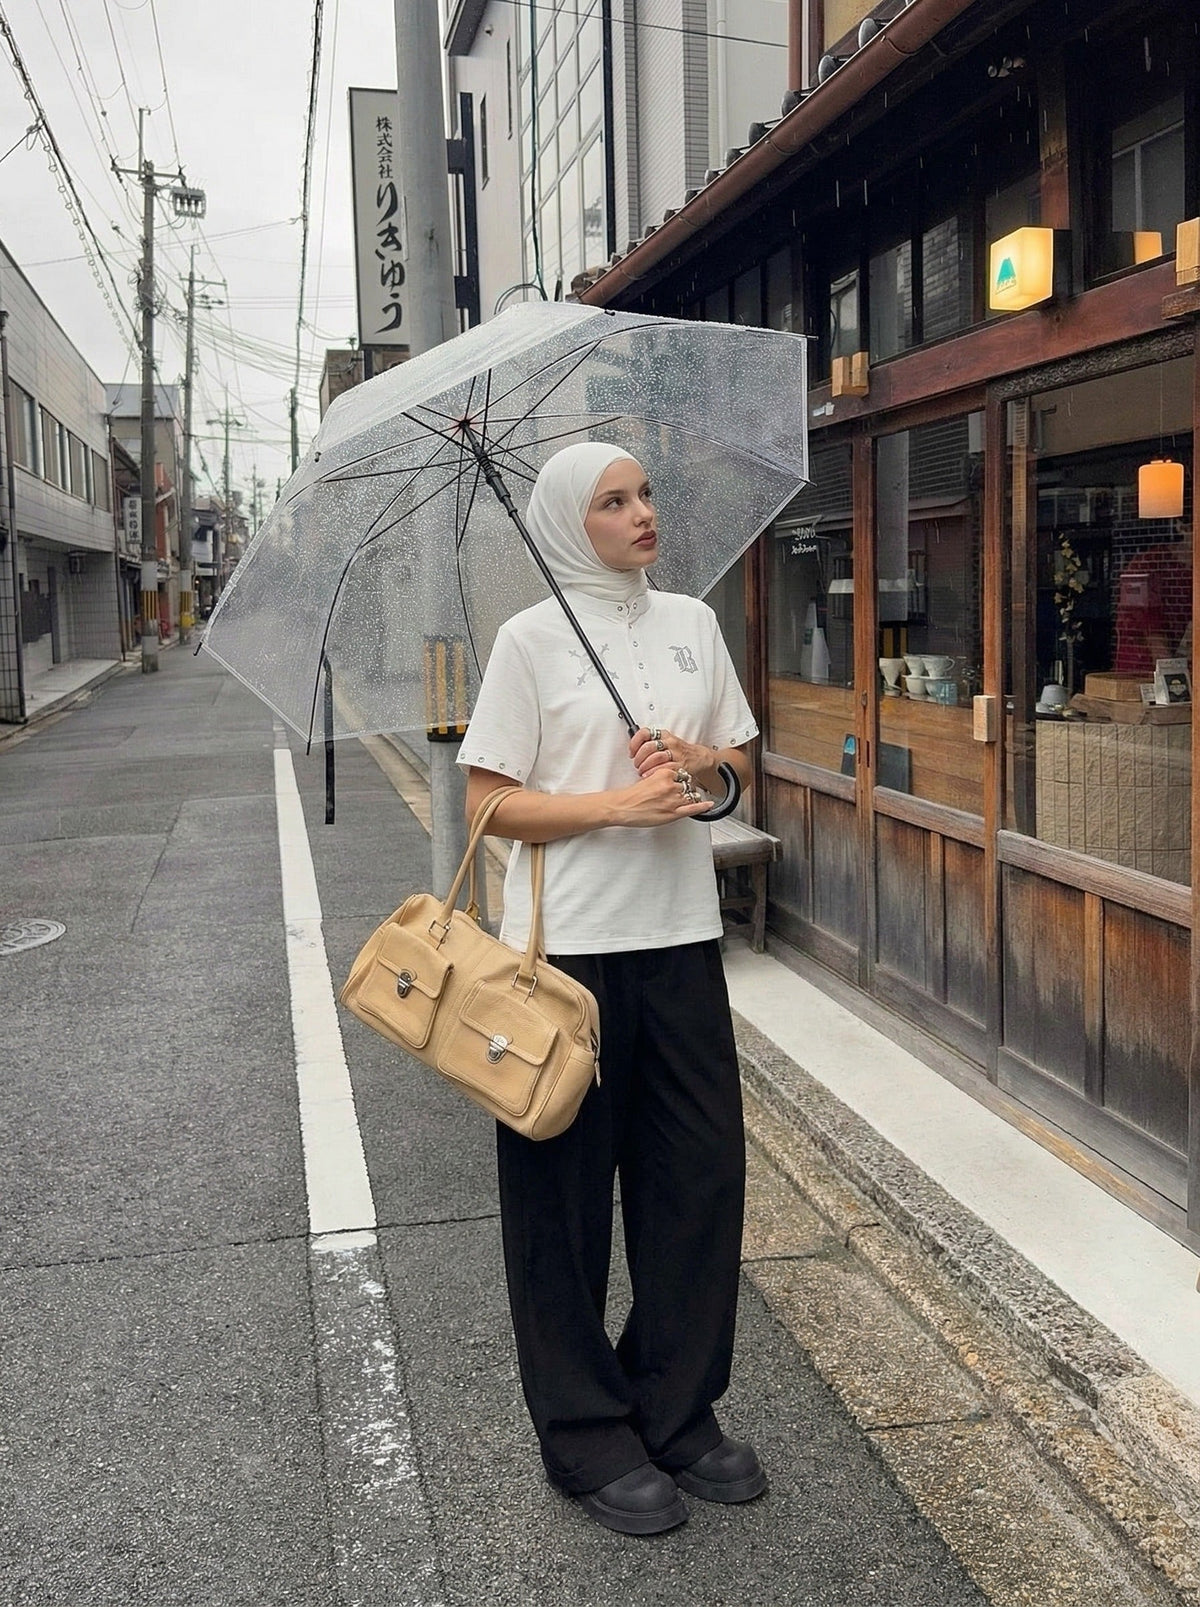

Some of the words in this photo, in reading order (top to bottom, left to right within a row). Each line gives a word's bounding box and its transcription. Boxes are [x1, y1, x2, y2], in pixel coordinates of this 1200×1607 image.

[375, 115, 405, 334] 株式会社りきゅう
[668, 645, 698, 674] B
